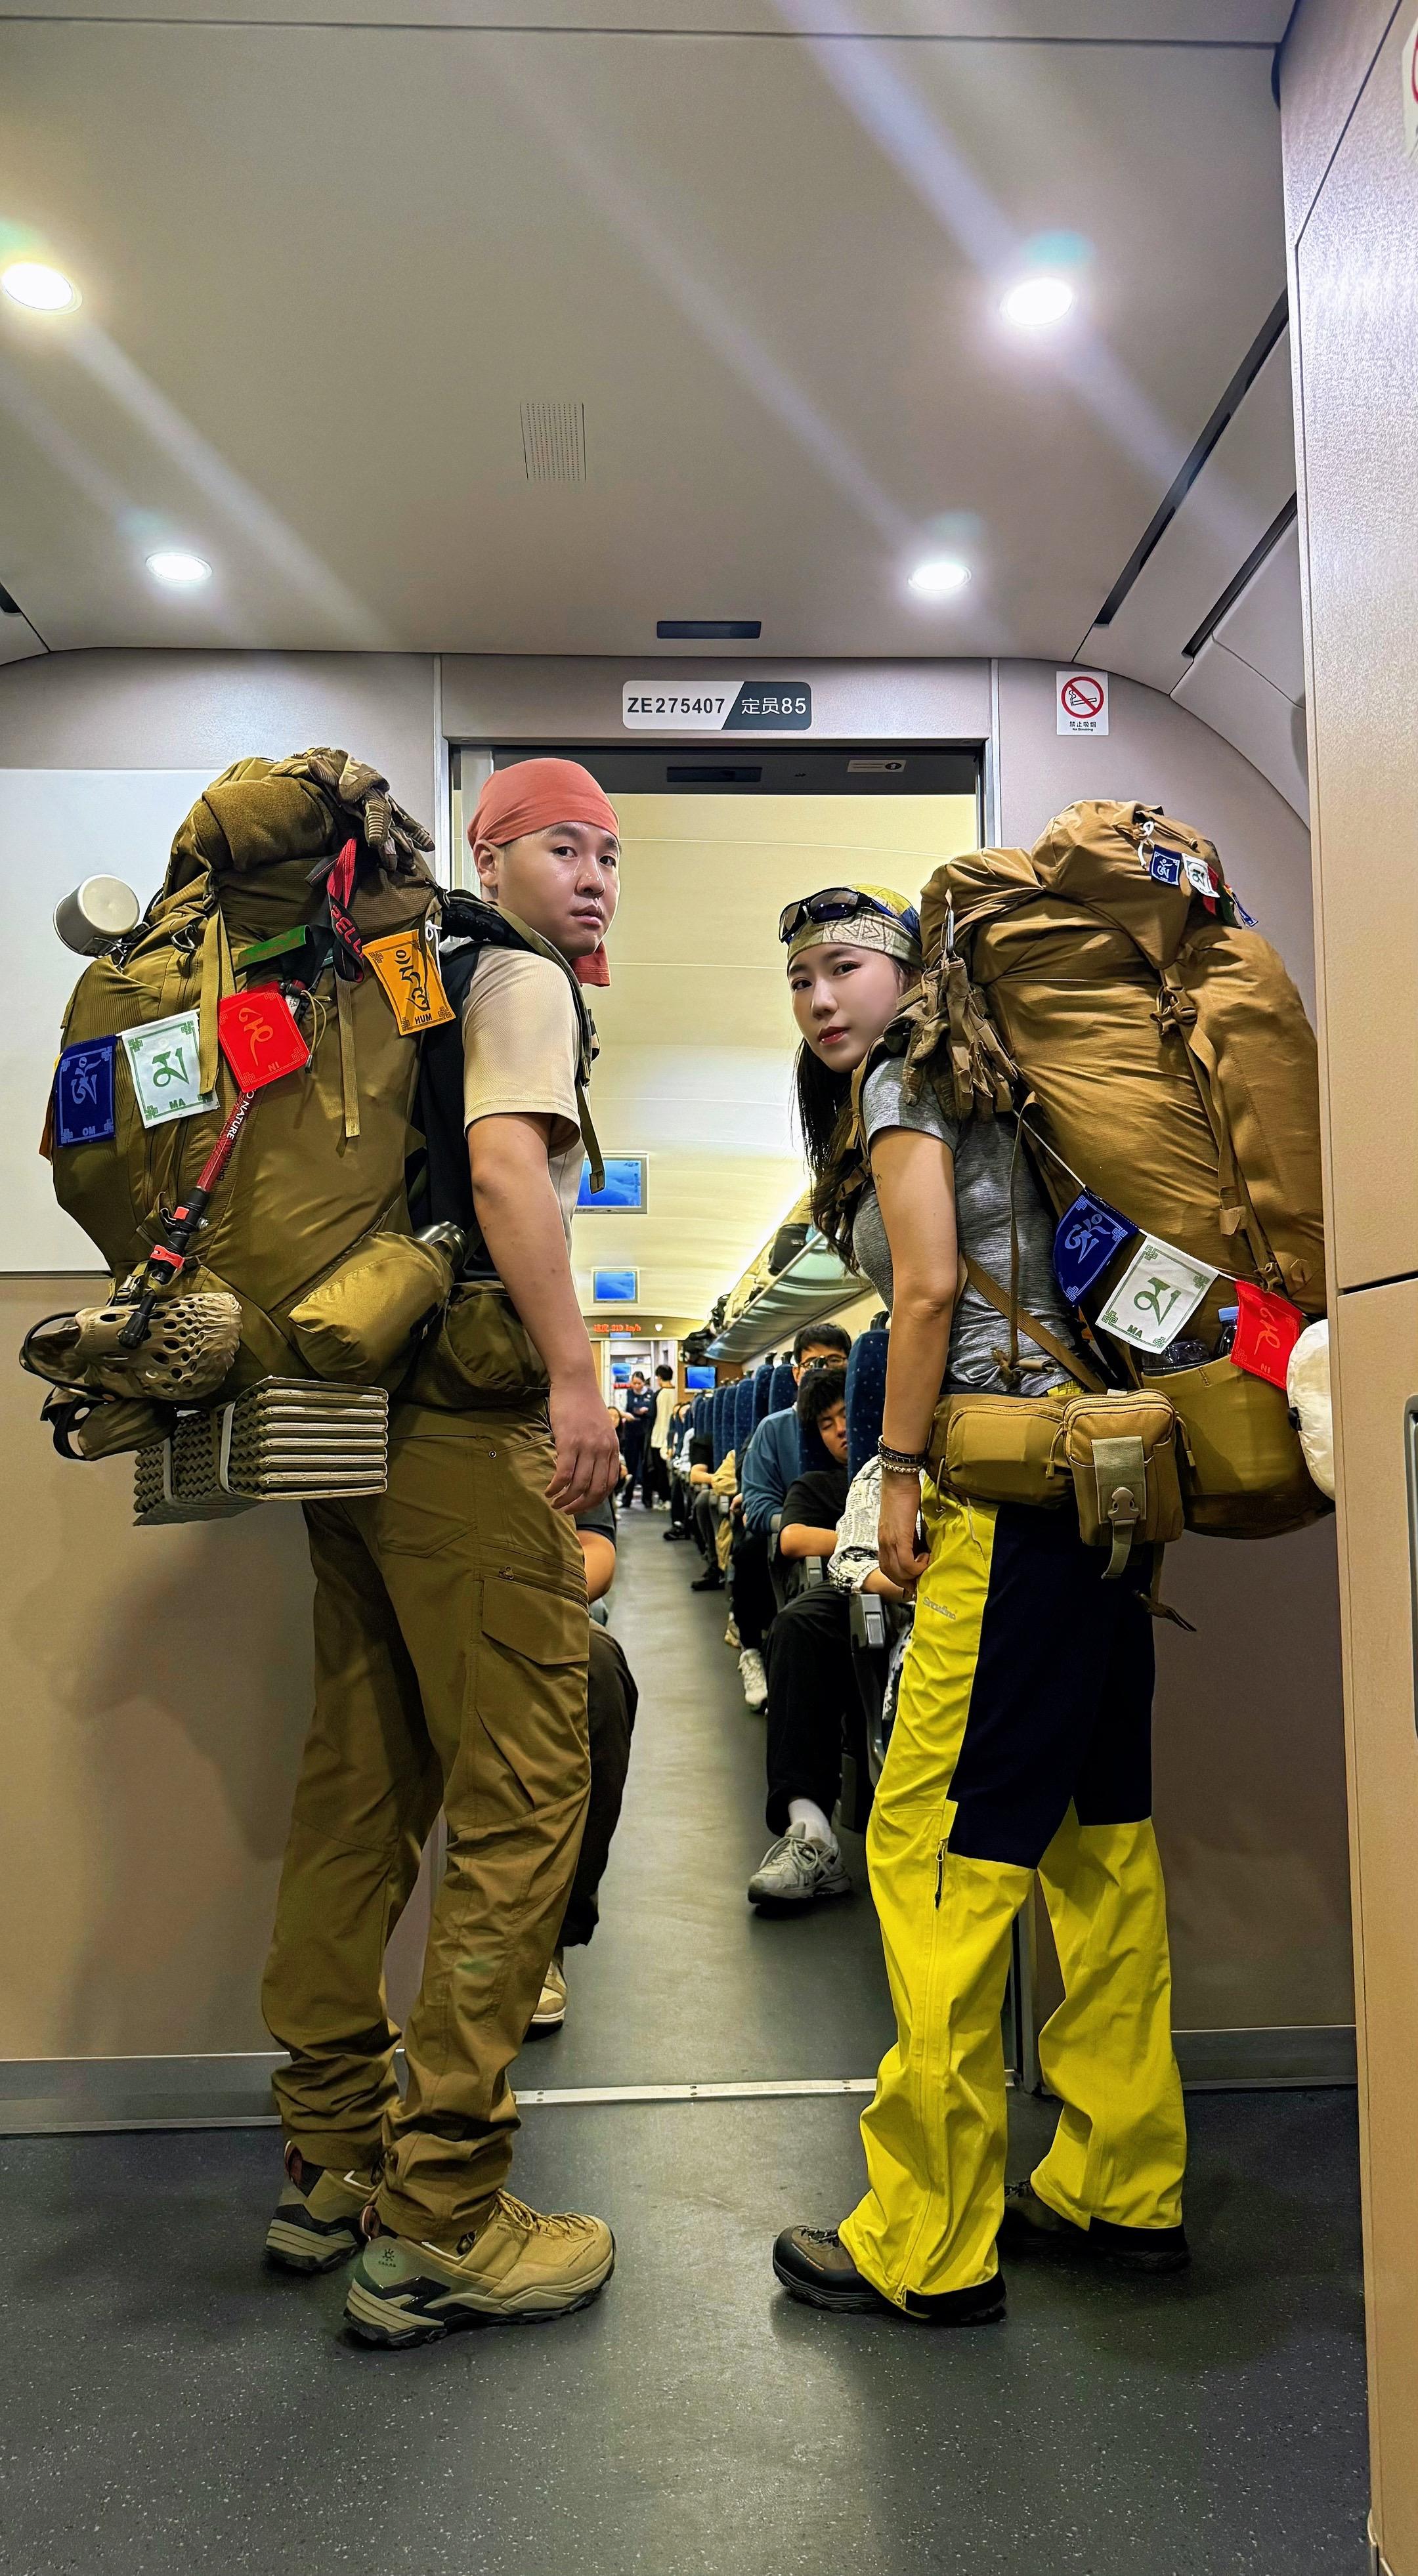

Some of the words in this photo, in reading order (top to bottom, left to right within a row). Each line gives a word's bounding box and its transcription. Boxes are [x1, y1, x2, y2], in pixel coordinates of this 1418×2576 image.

[627, 697, 725, 714] ZE275407
[741, 697, 806, 715] 定员85
[331, 905, 364, 958] PELL
[414, 1013, 433, 1025] HUM
[267, 1061, 280, 1072] NI
[169, 1098, 186, 1109] MA
[226, 1100, 250, 1140] NATURE
[82, 1125, 96, 1136] OM
[1127, 1325, 1143, 1339] MA
[1260, 1363, 1271, 1374] NI
